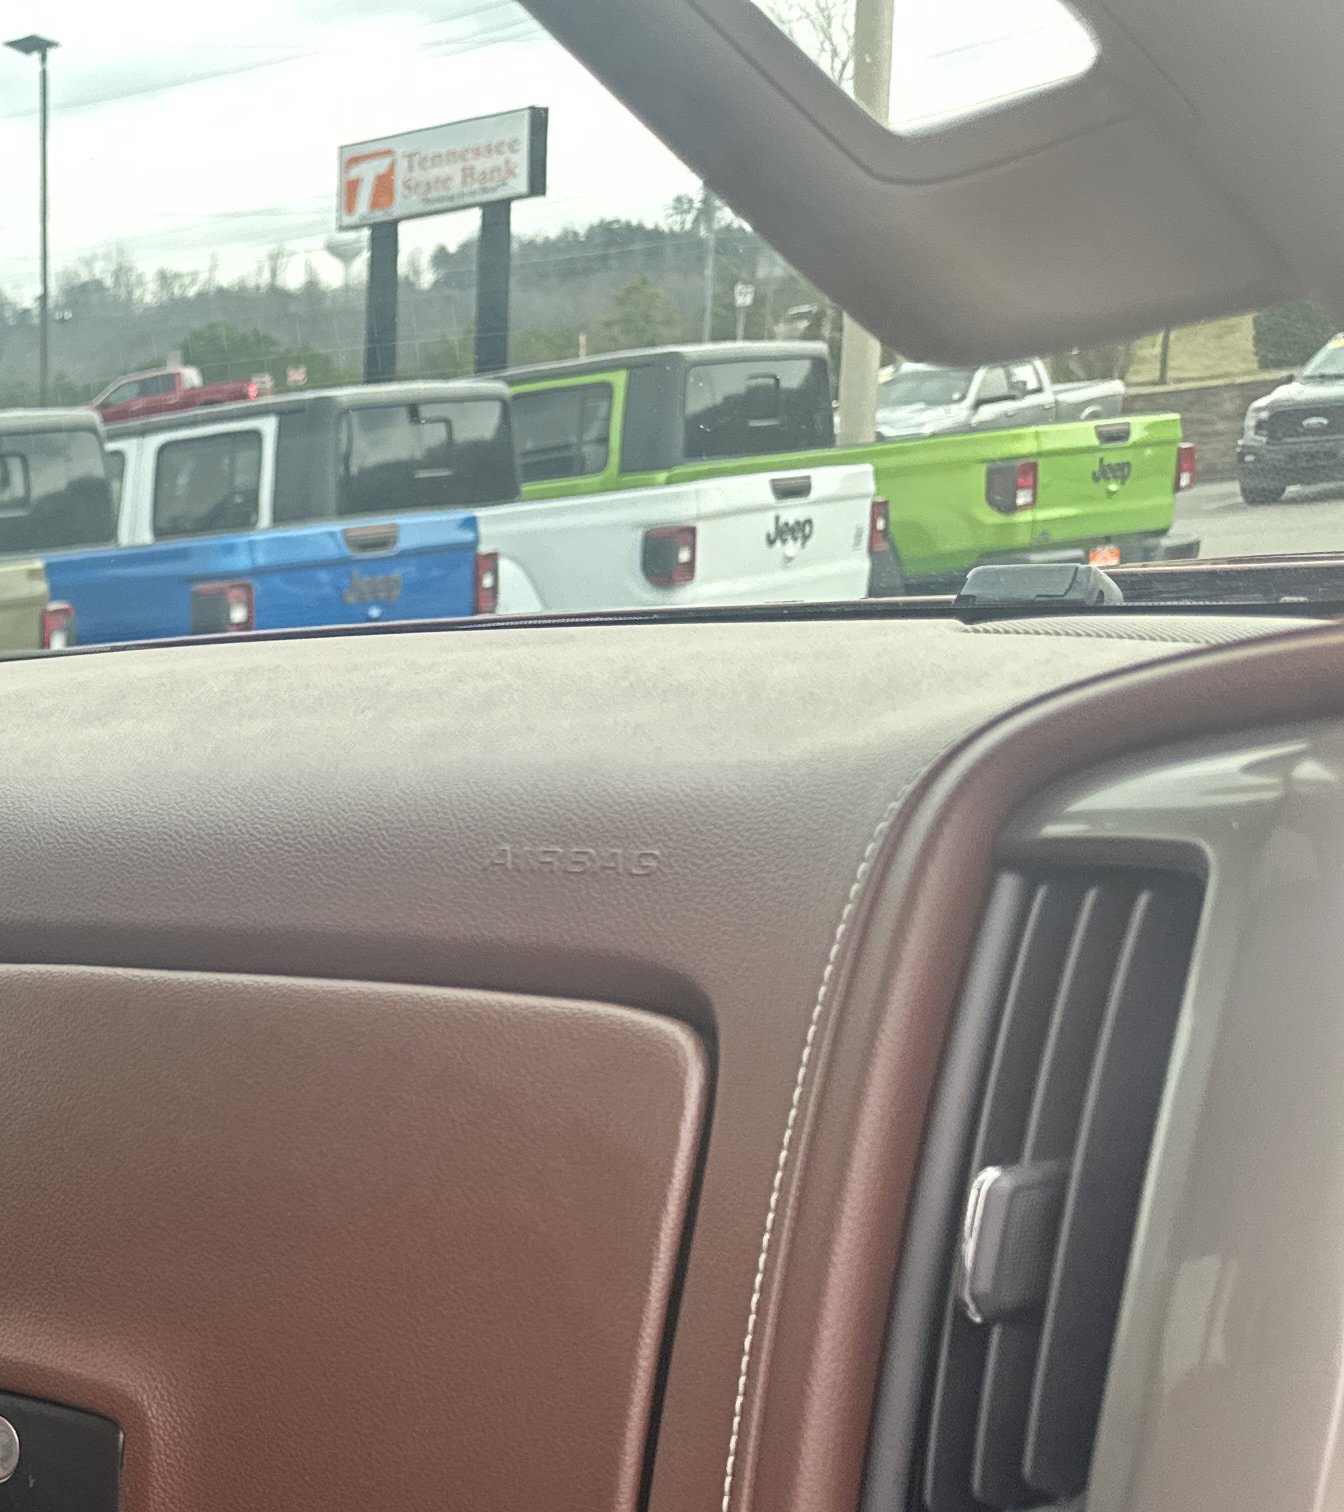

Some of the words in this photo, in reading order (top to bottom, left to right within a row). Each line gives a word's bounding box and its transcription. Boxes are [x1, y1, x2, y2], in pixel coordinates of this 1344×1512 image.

[401, 138, 521, 173] Tennessee
[461, 156, 518, 185] Bank
[1091, 456, 1132, 486] Jeep
[765, 514, 813, 549] Jeep
[488, 846, 662, 877] AIRBAG
